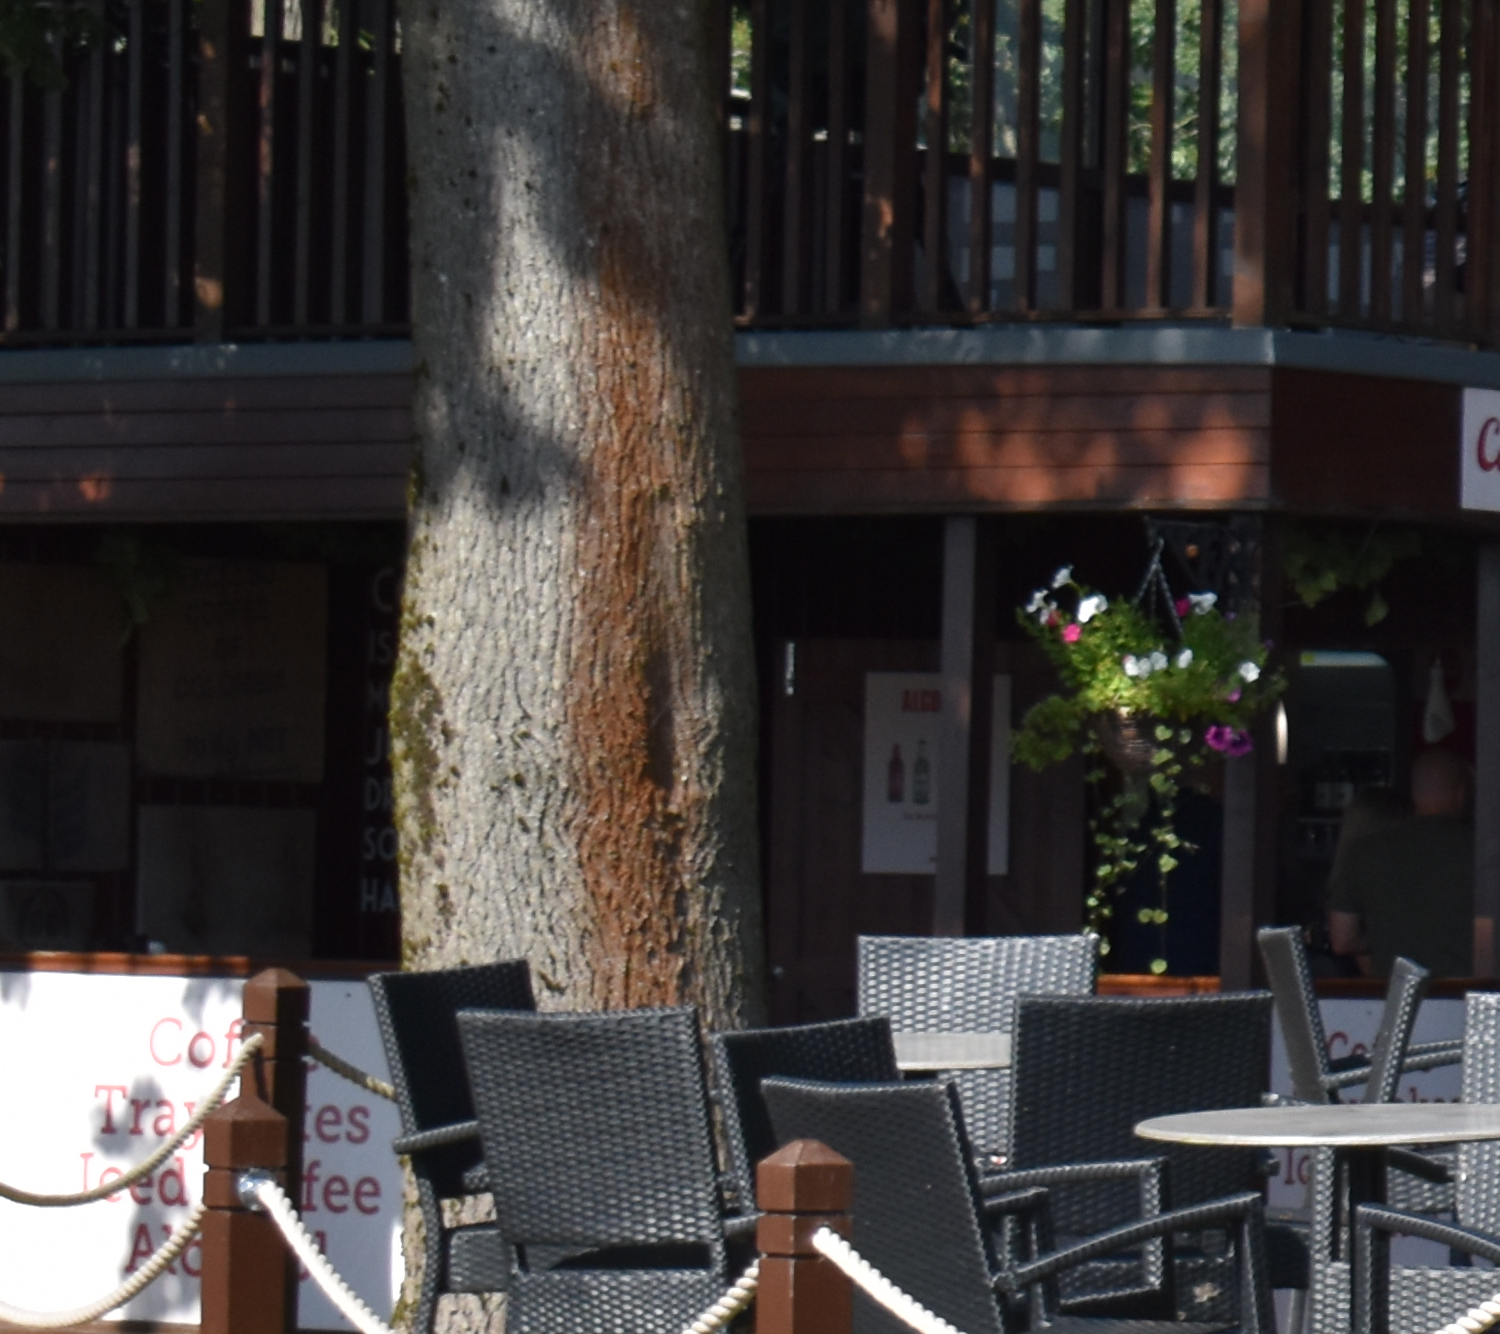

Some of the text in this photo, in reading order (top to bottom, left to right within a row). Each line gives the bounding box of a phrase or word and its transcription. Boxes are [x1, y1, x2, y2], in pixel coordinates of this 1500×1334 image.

[902, 689, 941, 712] ALCO
[363, 826, 398, 860] SO
[360, 877, 397, 913] HA
